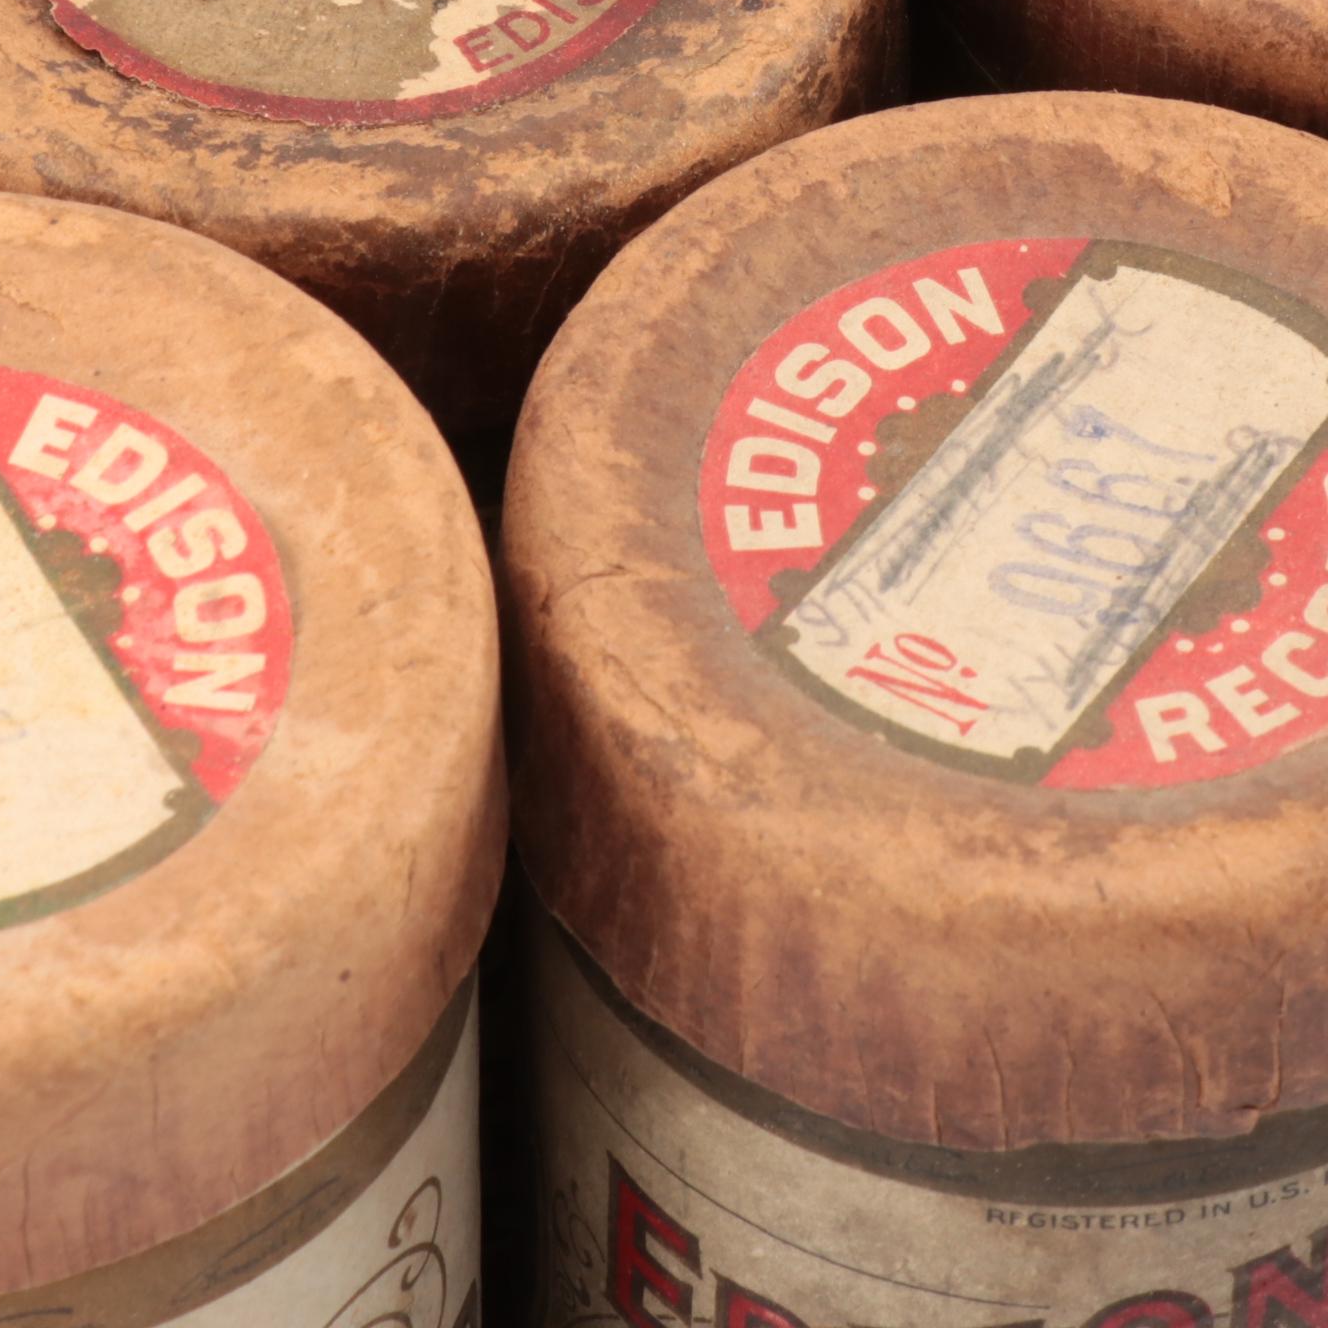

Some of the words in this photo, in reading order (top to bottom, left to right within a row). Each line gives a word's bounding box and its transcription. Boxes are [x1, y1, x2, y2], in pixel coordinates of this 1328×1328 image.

[723, 266, 1005, 553] EDISON
[7, 392, 268, 715] EDISON
[985, 1206, 1186, 1231] REGISTERED
[1199, 1199, 1232, 1221] IN
[1248, 1180, 1311, 1211] U.S.
